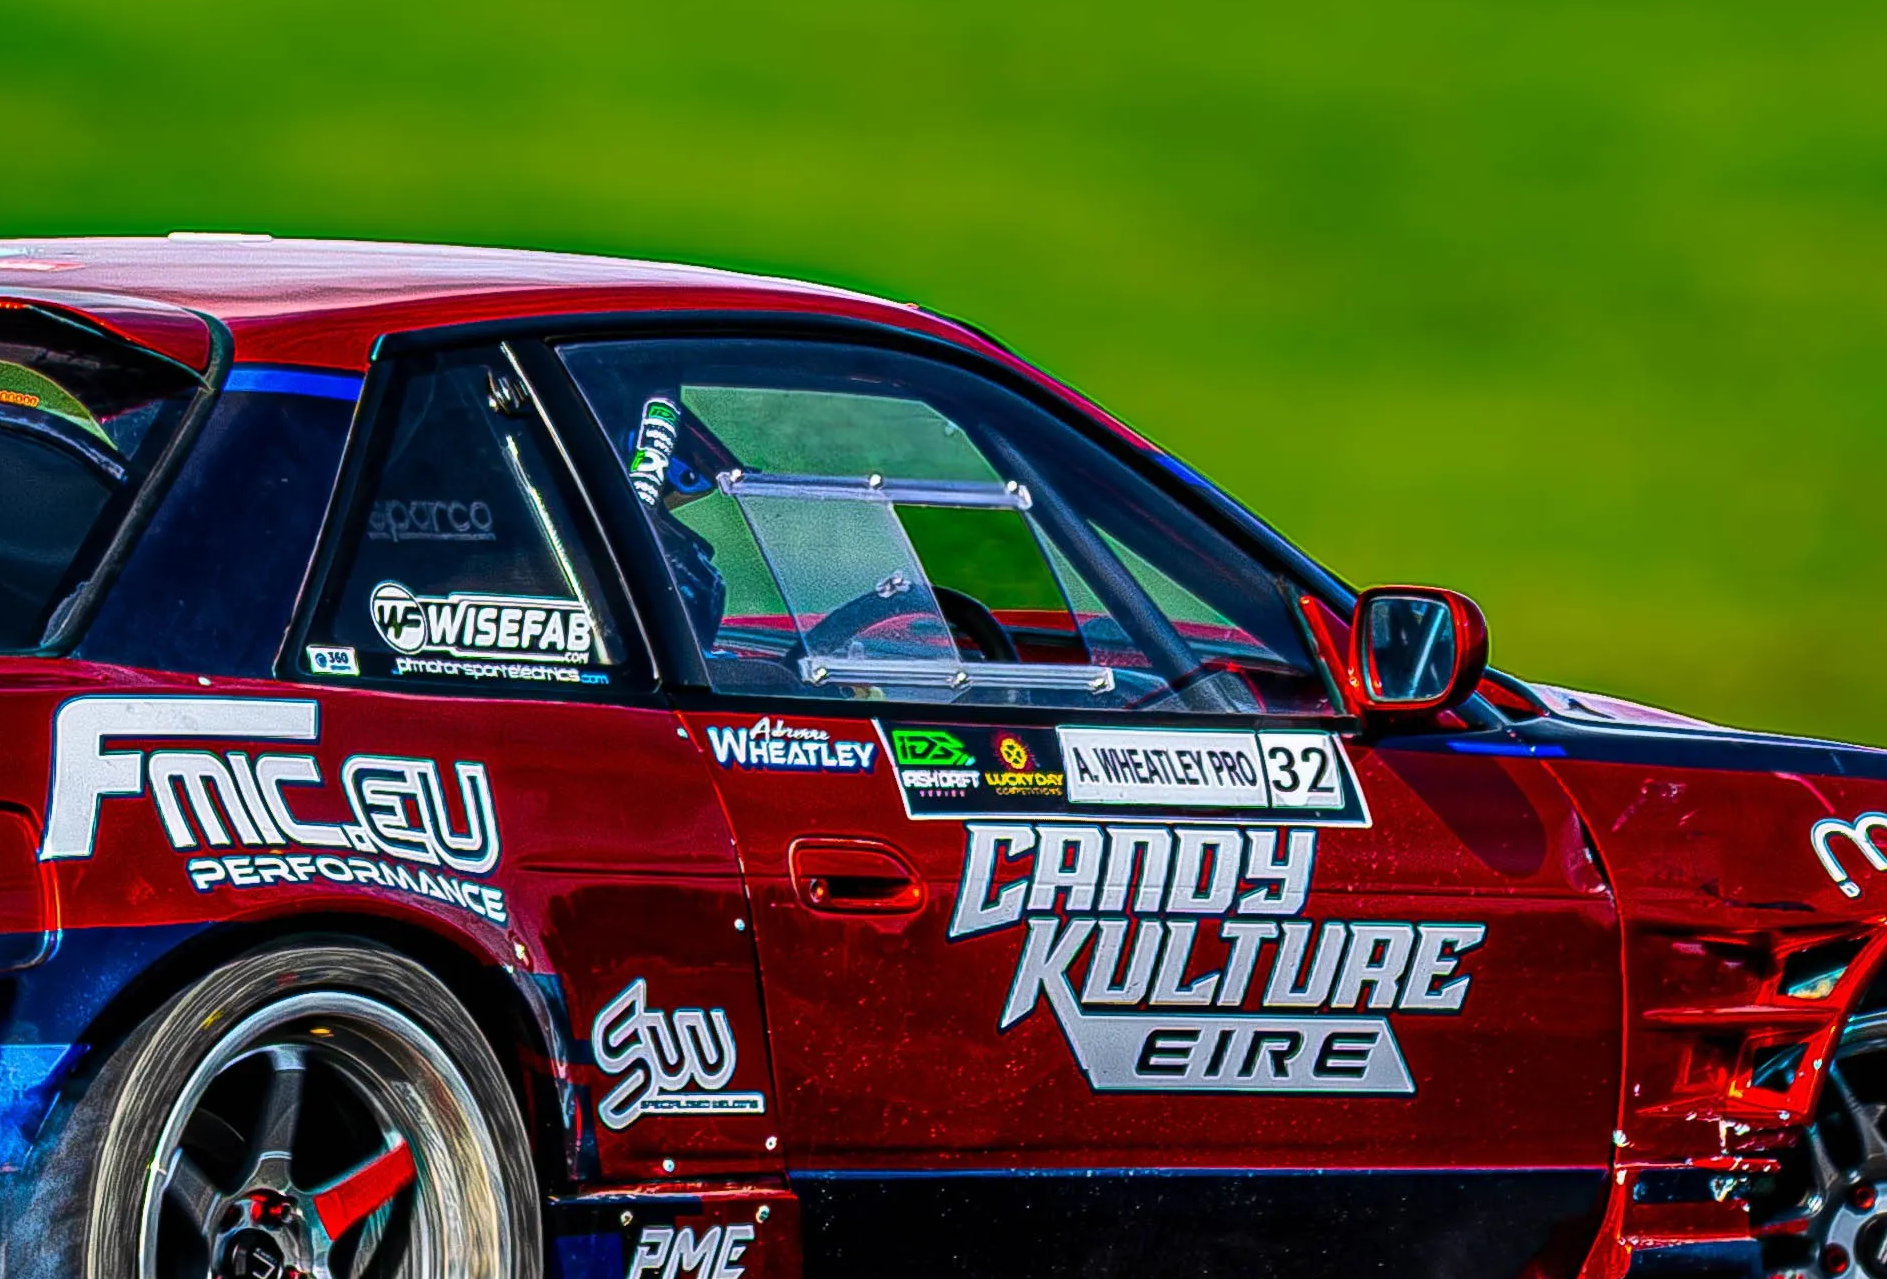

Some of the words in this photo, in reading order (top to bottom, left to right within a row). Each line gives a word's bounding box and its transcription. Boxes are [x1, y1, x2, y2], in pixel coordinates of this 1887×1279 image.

[428, 603, 591, 652] WISEFAB
[707, 727, 877, 771] WHEATLEY
[1071, 746, 1099, 783] A.
[1094, 747, 1209, 787] WHEATLEY
[1206, 750, 1258, 787] PRO
[1267, 746, 1335, 794] 32
[190, 855, 507, 922] PERFORMANCE
[950, 824, 1315, 940] CANDY
[999, 919, 1487, 1032] KULTURE
[1135, 1029, 1381, 1079] EIRE
